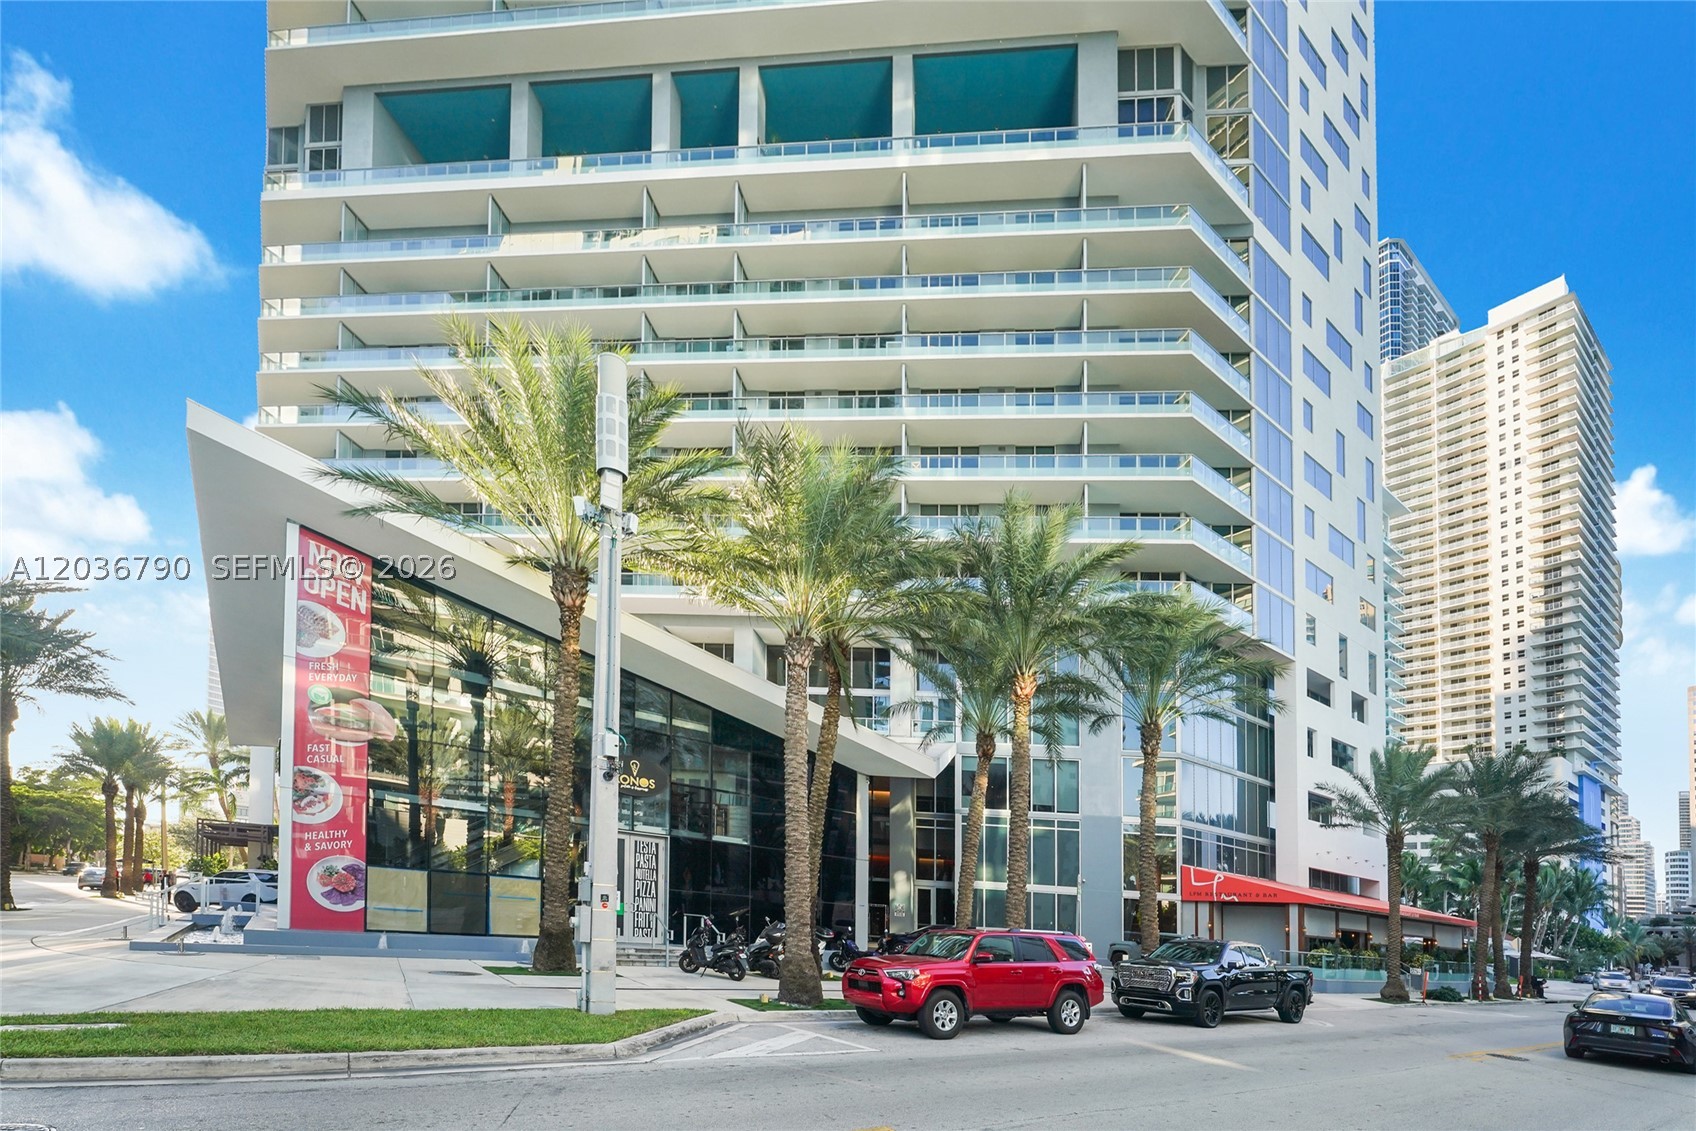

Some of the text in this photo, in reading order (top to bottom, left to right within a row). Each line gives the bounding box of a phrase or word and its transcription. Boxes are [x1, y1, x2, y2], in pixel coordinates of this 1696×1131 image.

[308, 540, 366, 585] NOW
[303, 567, 367, 615] OPEN
[308, 661, 339, 671] FRESH
[308, 672, 358, 683] EVERYDAY
[306, 743, 331, 753] FAST
[306, 754, 345, 764] CASUAL
[304, 829, 348, 841] HEALTHY
[304, 840, 354, 852] & SAVORY
[635, 853, 657, 870] PASTA
[635, 879, 657, 898] PIZZA
